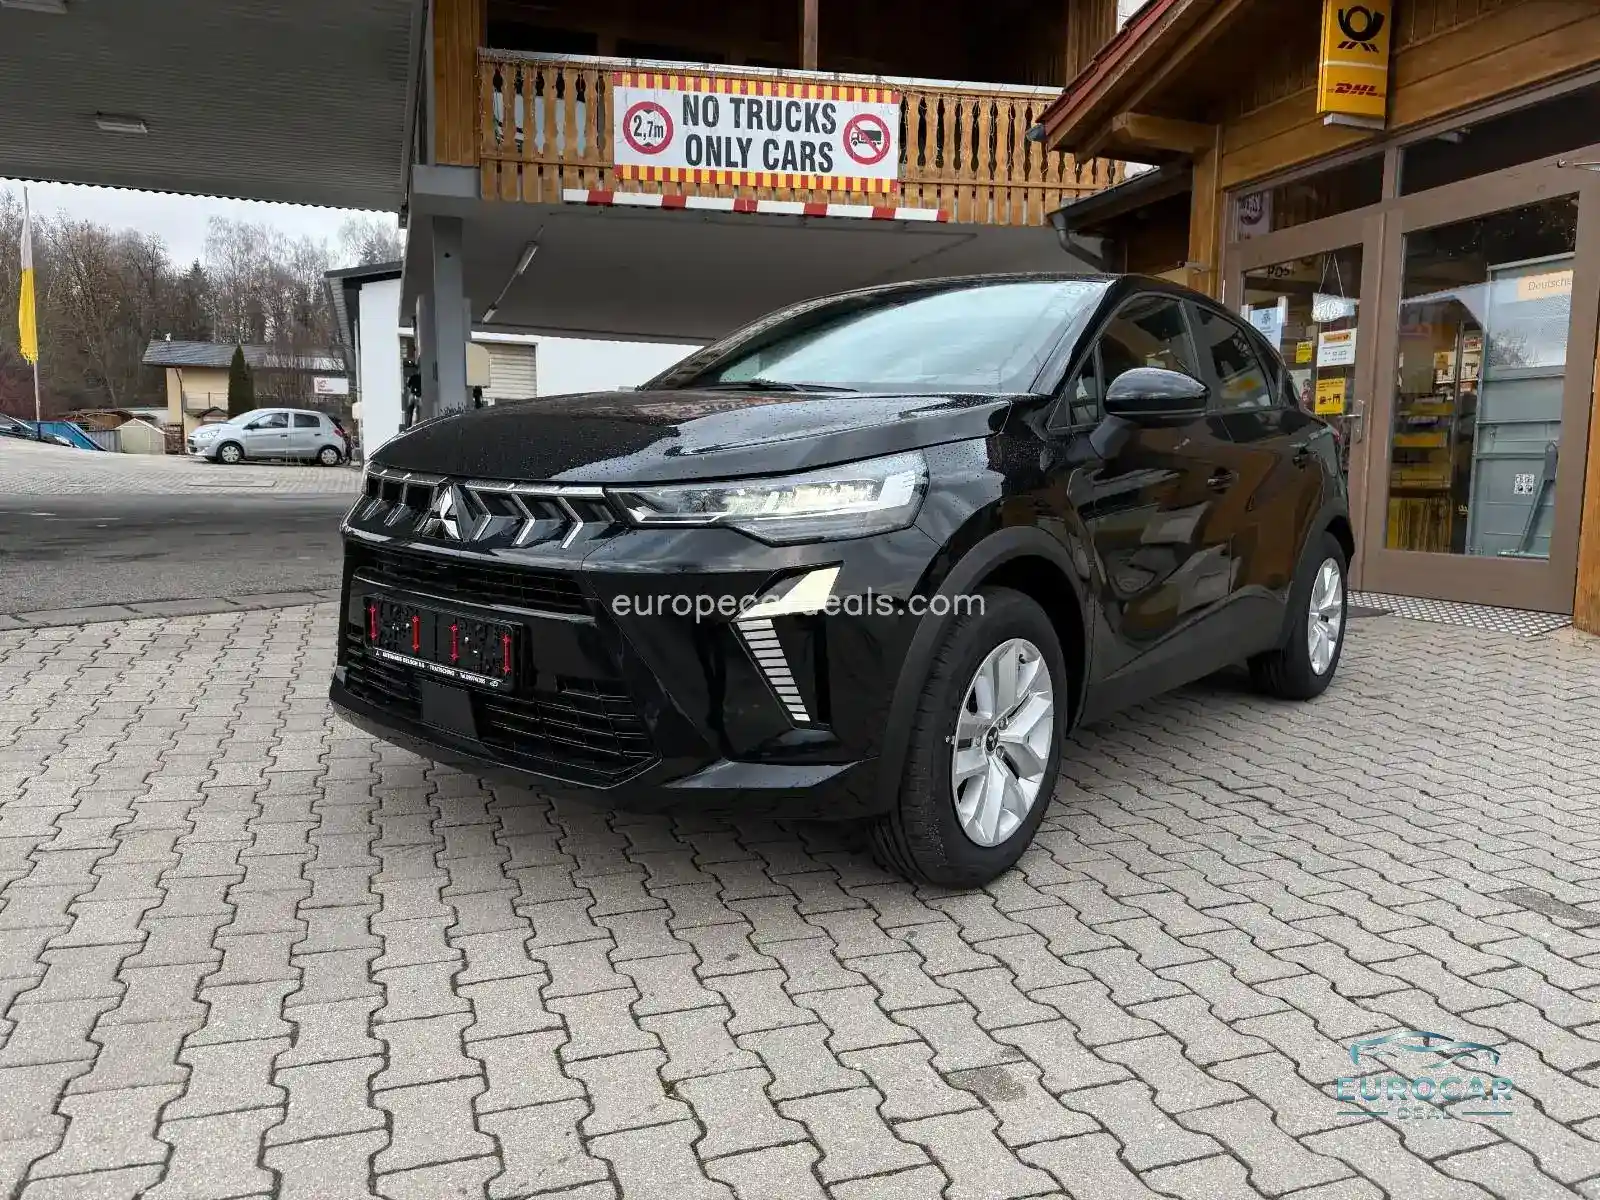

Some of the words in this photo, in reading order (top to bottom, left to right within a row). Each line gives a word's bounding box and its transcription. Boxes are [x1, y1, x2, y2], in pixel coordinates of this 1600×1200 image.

[1335, 82, 1378, 97] DHL
[633, 114, 664, 141] 2,7m
[682, 94, 720, 128] NO
[729, 97, 838, 135] TRUCKS
[685, 134, 753, 168] ONLY
[762, 138, 834, 173] CARS
